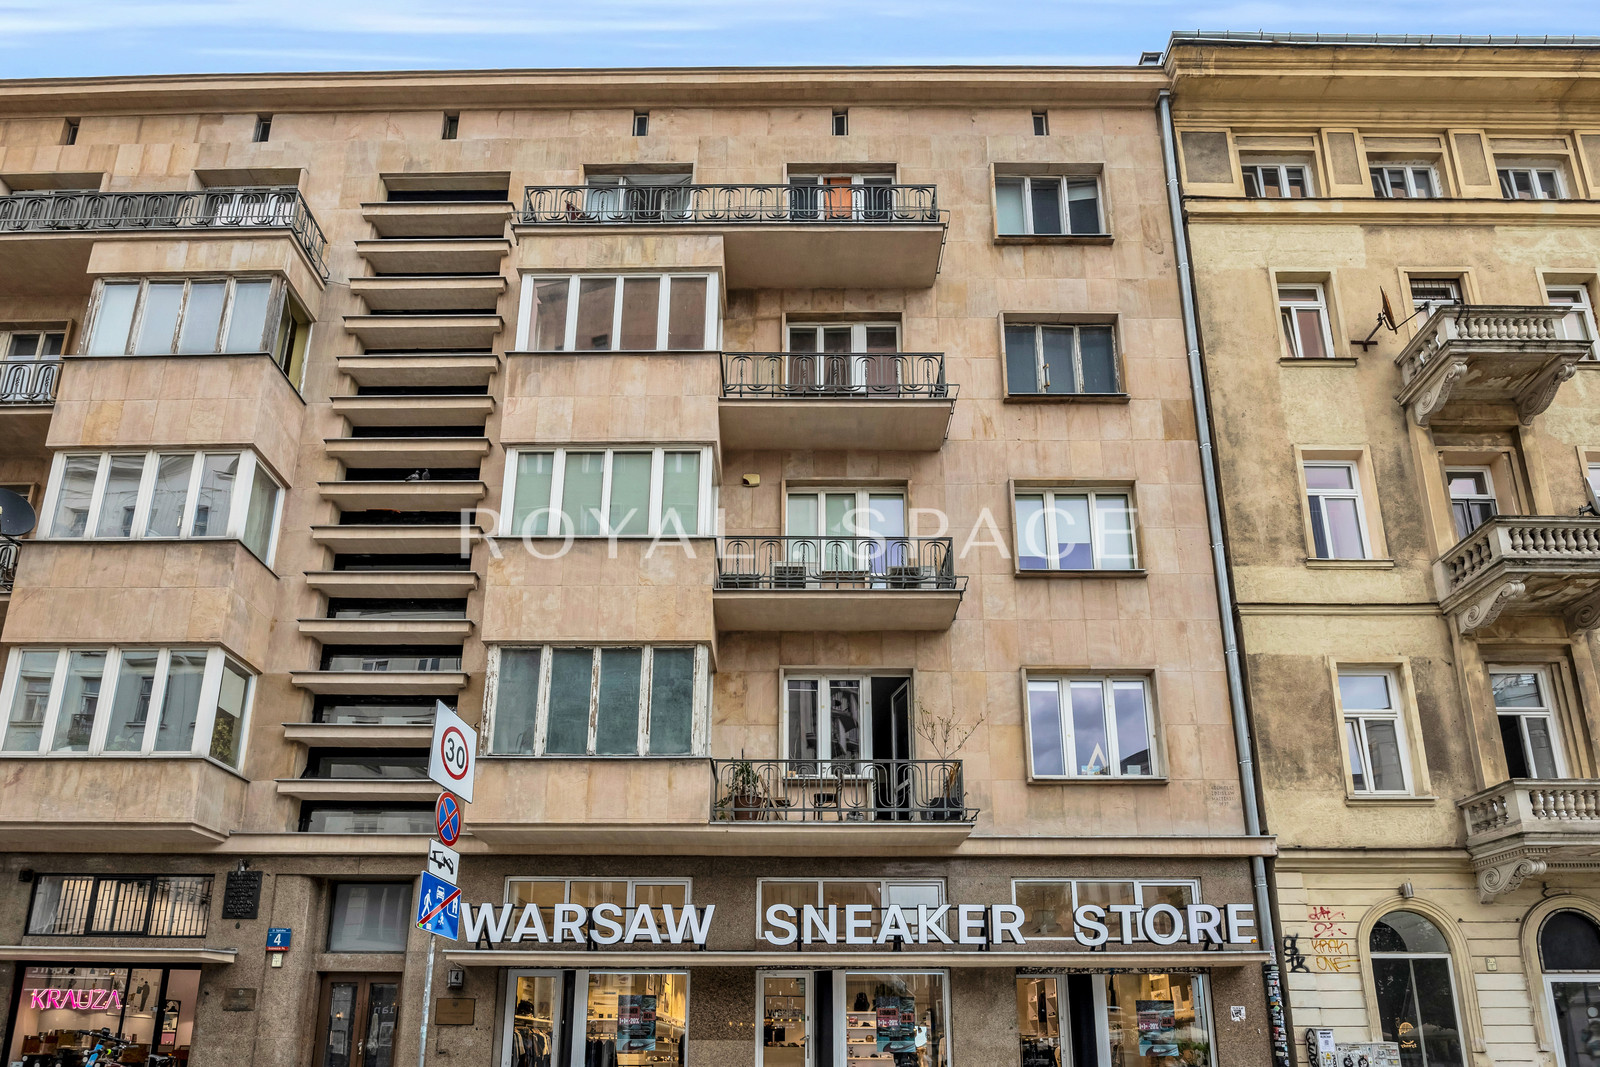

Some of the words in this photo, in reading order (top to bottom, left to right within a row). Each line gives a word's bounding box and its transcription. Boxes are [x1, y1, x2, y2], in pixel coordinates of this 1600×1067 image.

[445, 737, 466, 770] 30
[460, 903, 716, 945] WARSAW
[764, 904, 1027, 946] SNEAKER
[1073, 904, 1255, 947] STORE
[273, 933, 282, 946] 4
[454, 971, 460, 982] 4
[30, 988, 121, 1010] KRAUZA
